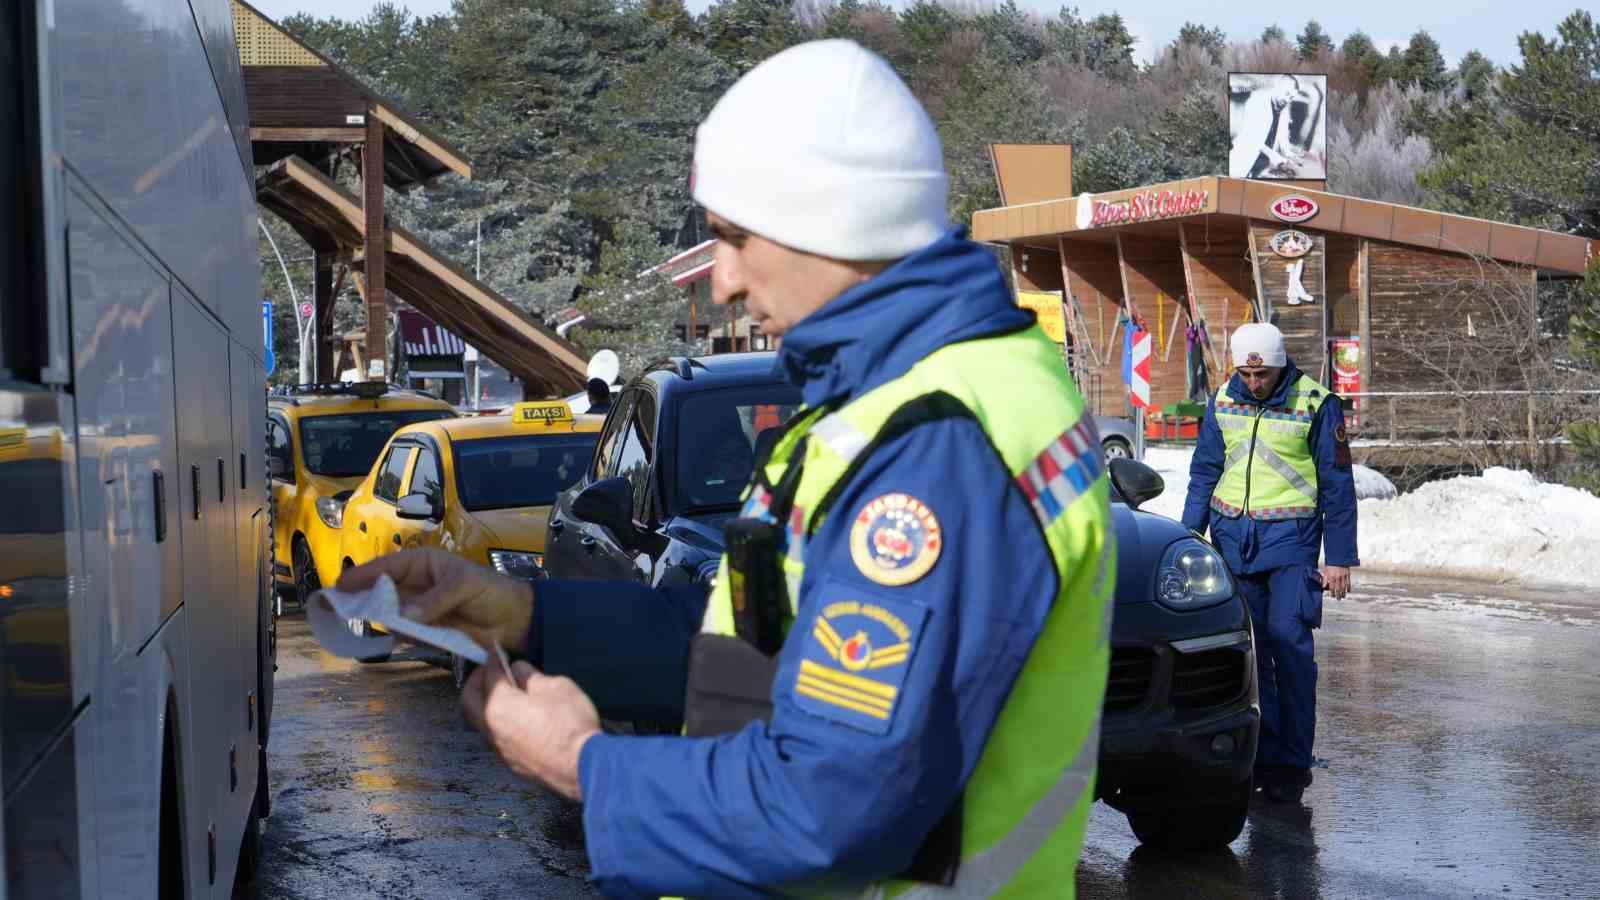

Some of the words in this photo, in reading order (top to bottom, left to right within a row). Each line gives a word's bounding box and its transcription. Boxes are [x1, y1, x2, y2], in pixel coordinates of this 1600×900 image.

[1130, 190, 1157, 220] Ski
[1157, 190, 1208, 216] Center
[525, 407, 564, 418] TAKSI
